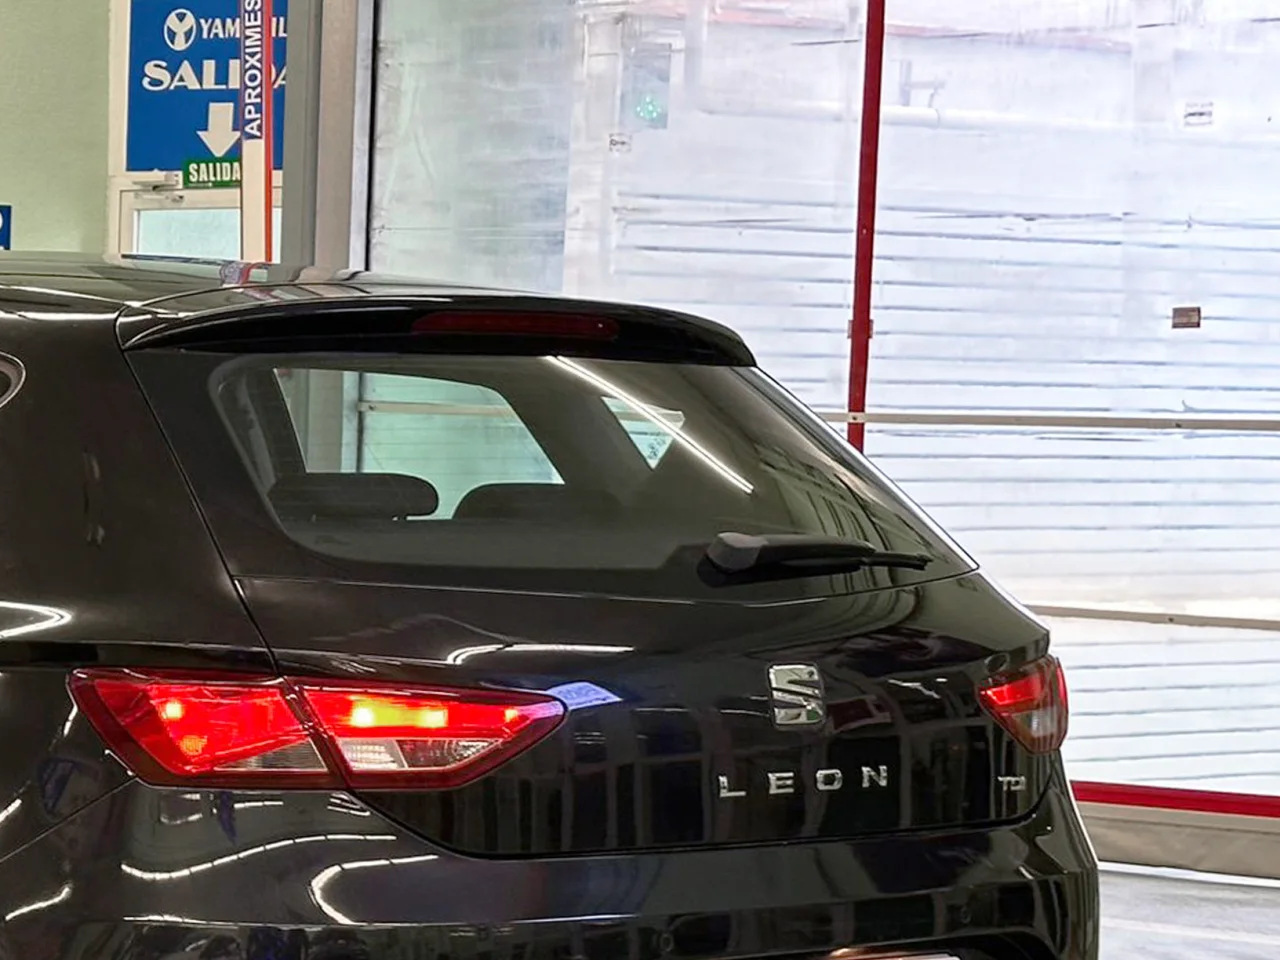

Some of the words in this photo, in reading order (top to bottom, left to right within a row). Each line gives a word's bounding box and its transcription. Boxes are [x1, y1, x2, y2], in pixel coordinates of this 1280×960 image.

[200, 16, 288, 39] YAMIL
[189, 162, 241, 182] SALIDA
[719, 764, 888, 797] LEON
